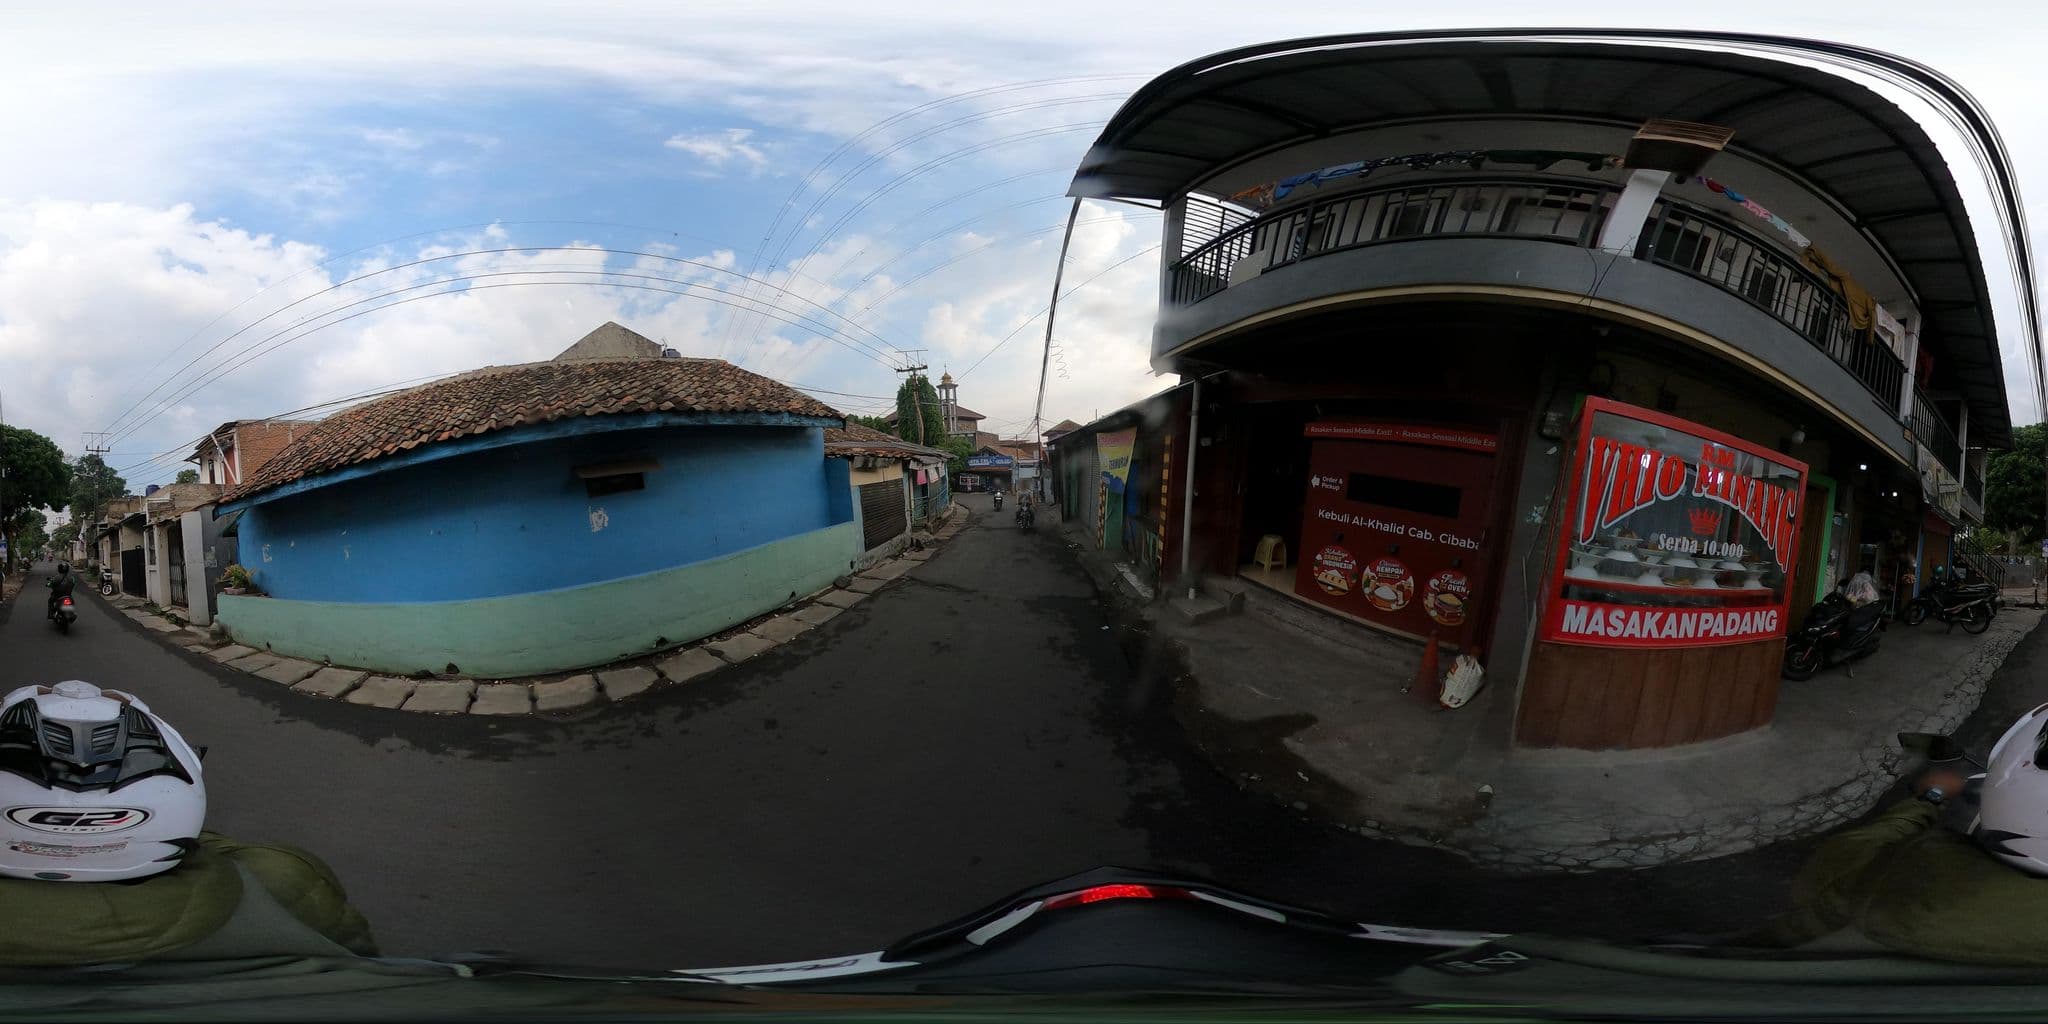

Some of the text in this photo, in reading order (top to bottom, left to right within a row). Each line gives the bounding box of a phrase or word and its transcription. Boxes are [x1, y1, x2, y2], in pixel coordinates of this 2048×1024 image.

[1402, 431, 1431, 439] Rasakan
[1432, 433, 1457, 442] Sensasi
[1458, 435, 1482, 445] Middle
[1321, 482, 1340, 492] Pickup
[1322, 476, 1338, 484] Order
[1580, 437, 1796, 573] VHIO MINANG
[1318, 509, 1350, 524] Kebuli
[1351, 515, 1405, 535] Al-Khalid
[1408, 528, 1435, 542] Cab.
[1658, 533, 1743, 558] Serba 10.000
[1447, 583, 1467, 593] OVEN
[1561, 604, 1778, 639] MASAKAN PADANG
[28, 810, 132, 827] G2
